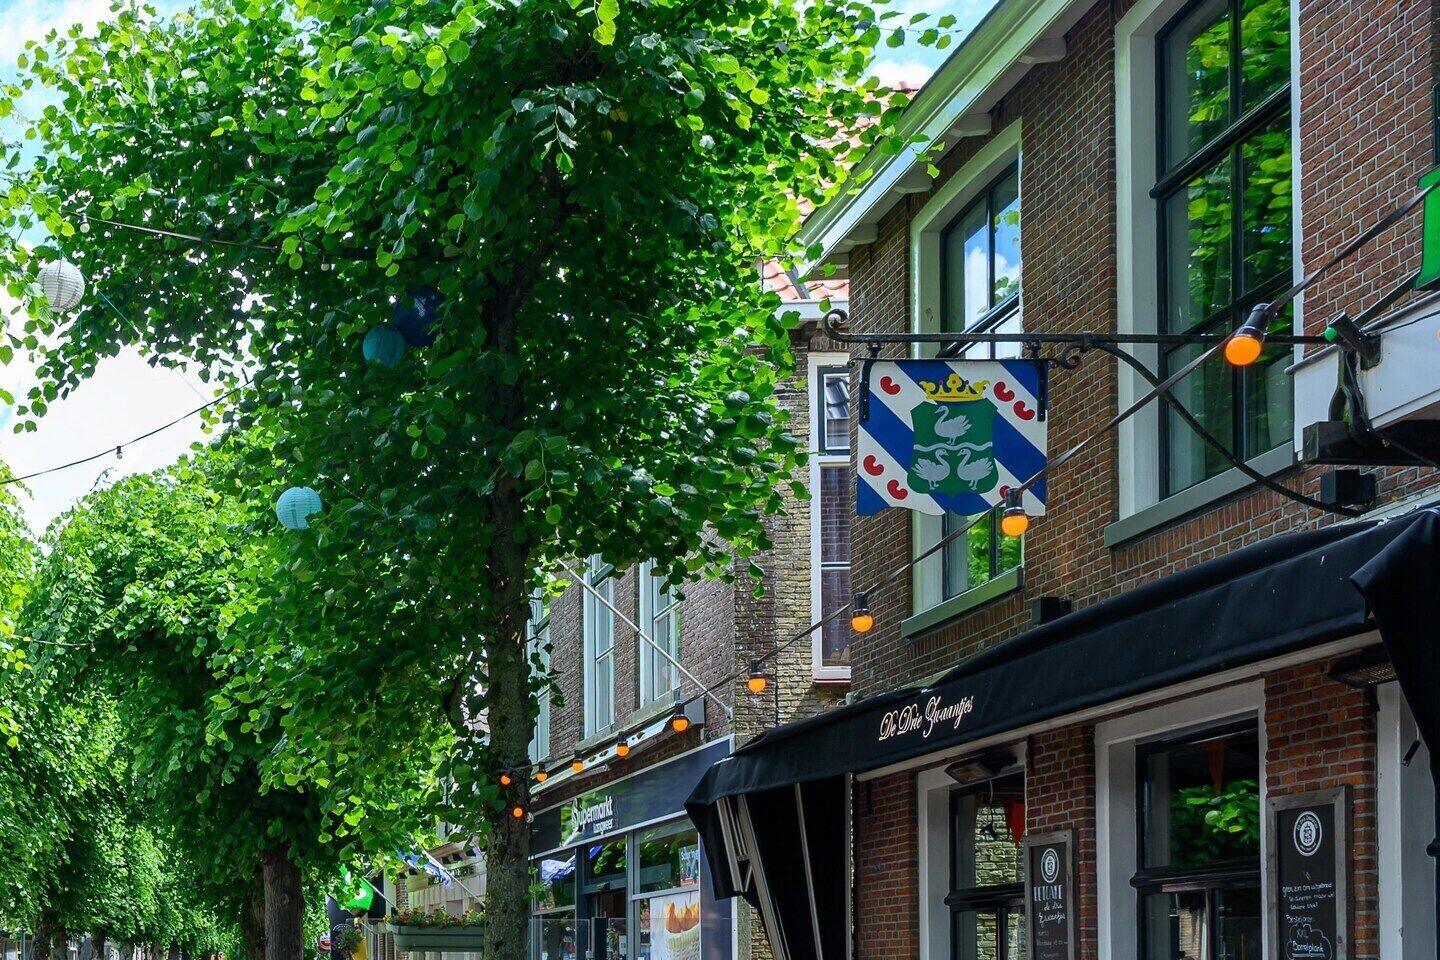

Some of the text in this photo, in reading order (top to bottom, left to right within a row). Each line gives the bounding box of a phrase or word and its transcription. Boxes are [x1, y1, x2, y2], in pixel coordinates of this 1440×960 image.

[879, 696, 974, 741] De Drie Zwaantjes
[570, 795, 613, 831] Supermarkt
